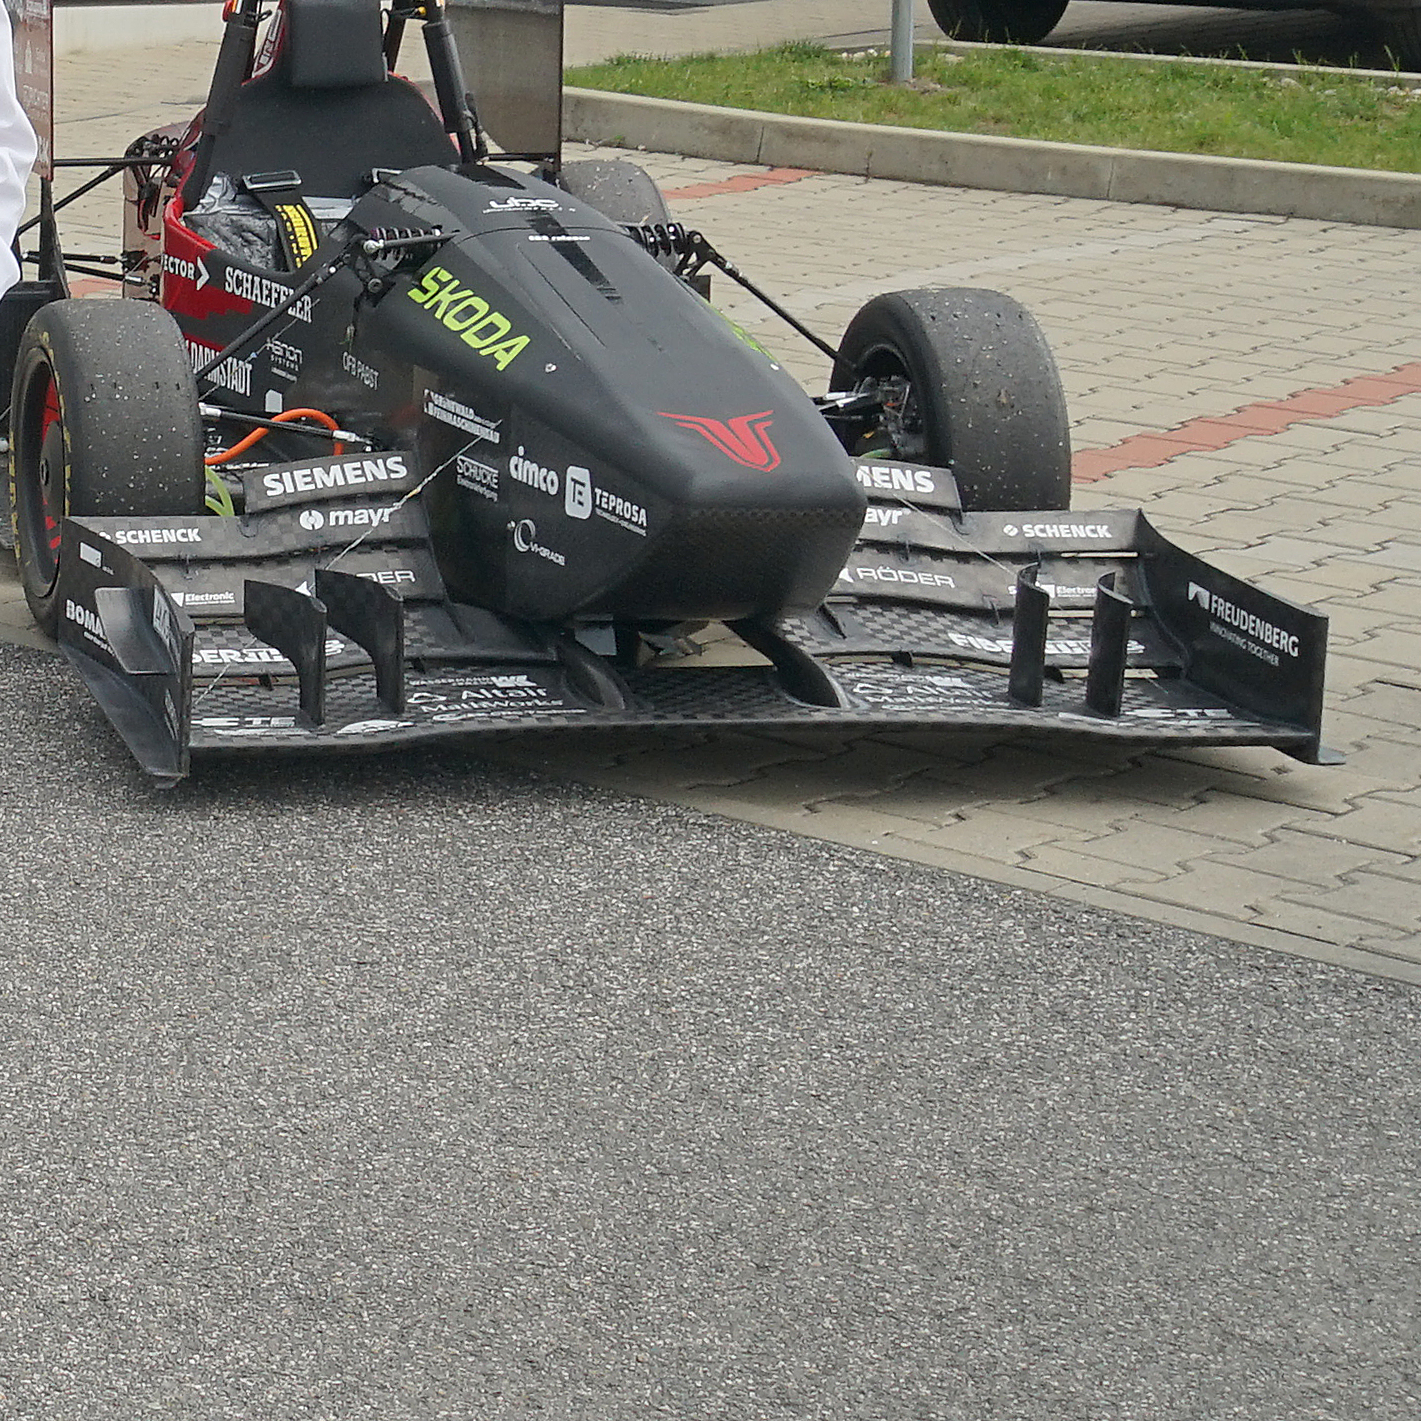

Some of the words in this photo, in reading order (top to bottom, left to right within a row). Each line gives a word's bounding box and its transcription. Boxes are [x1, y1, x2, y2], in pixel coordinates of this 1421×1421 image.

[161, 254, 195, 281] ECTOR
[263, 455, 408, 497] SIEMENS
[509, 445, 559, 496] cimco
[594, 487, 648, 527] TEPROSA
[864, 507, 903, 527] ayr
[115, 528, 202, 545] SCHENCK
[1022, 524, 1113, 539] SCHENCK
[856, 565, 956, 588] RÖDER
[185, 591, 235, 601] Electronic
[66, 599, 107, 641] BOMA
[1210, 593, 1300, 658] FREUDENBERG
[461, 687, 547, 700] Altair
